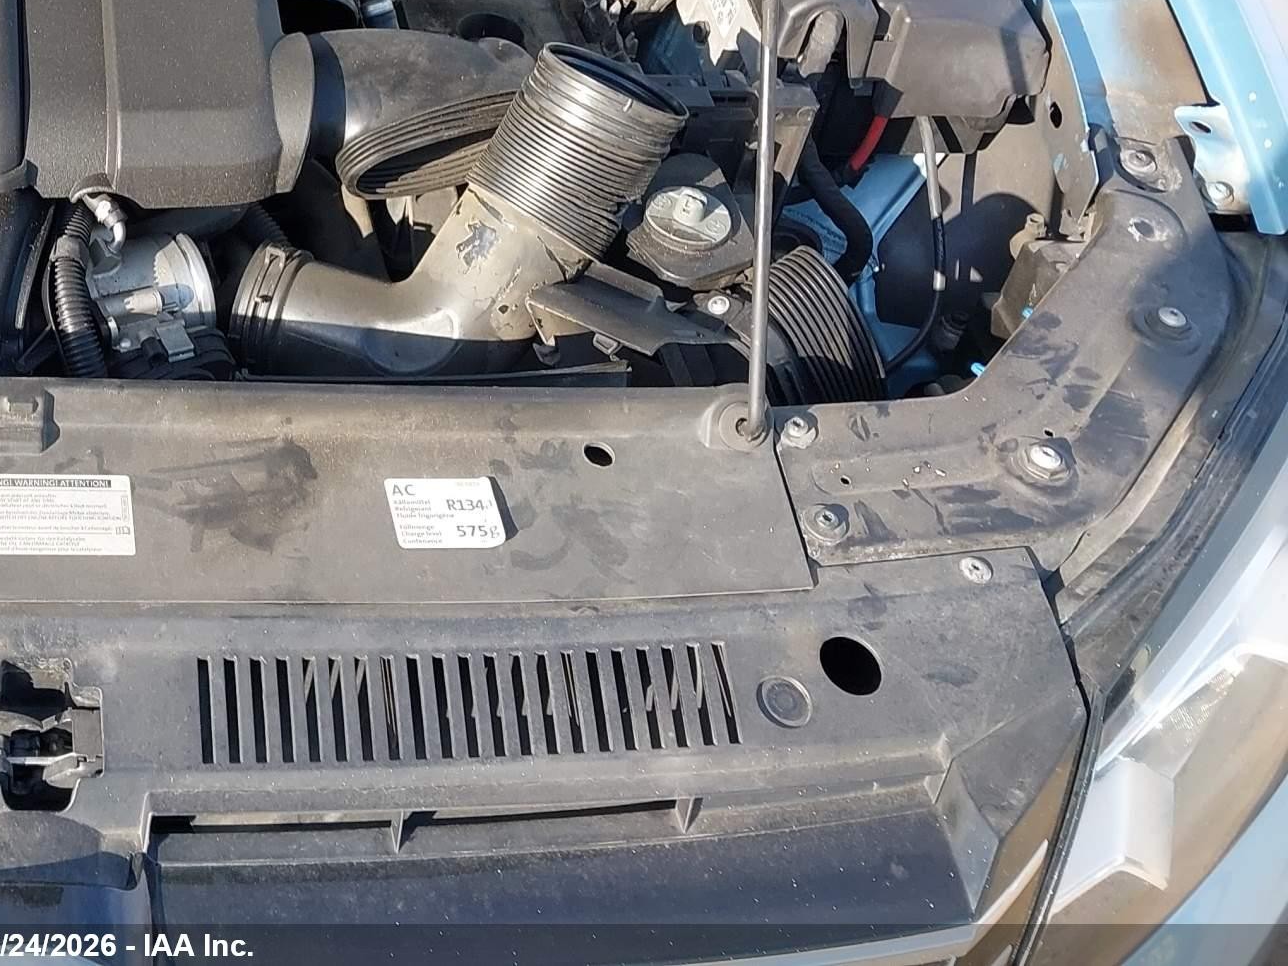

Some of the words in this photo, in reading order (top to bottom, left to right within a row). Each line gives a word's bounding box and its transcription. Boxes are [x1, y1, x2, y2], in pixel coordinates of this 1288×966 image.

[14, 479, 58, 488] WARNING!
[60, 479, 109, 488] ATTENTION!
[392, 484, 416, 497] AC
